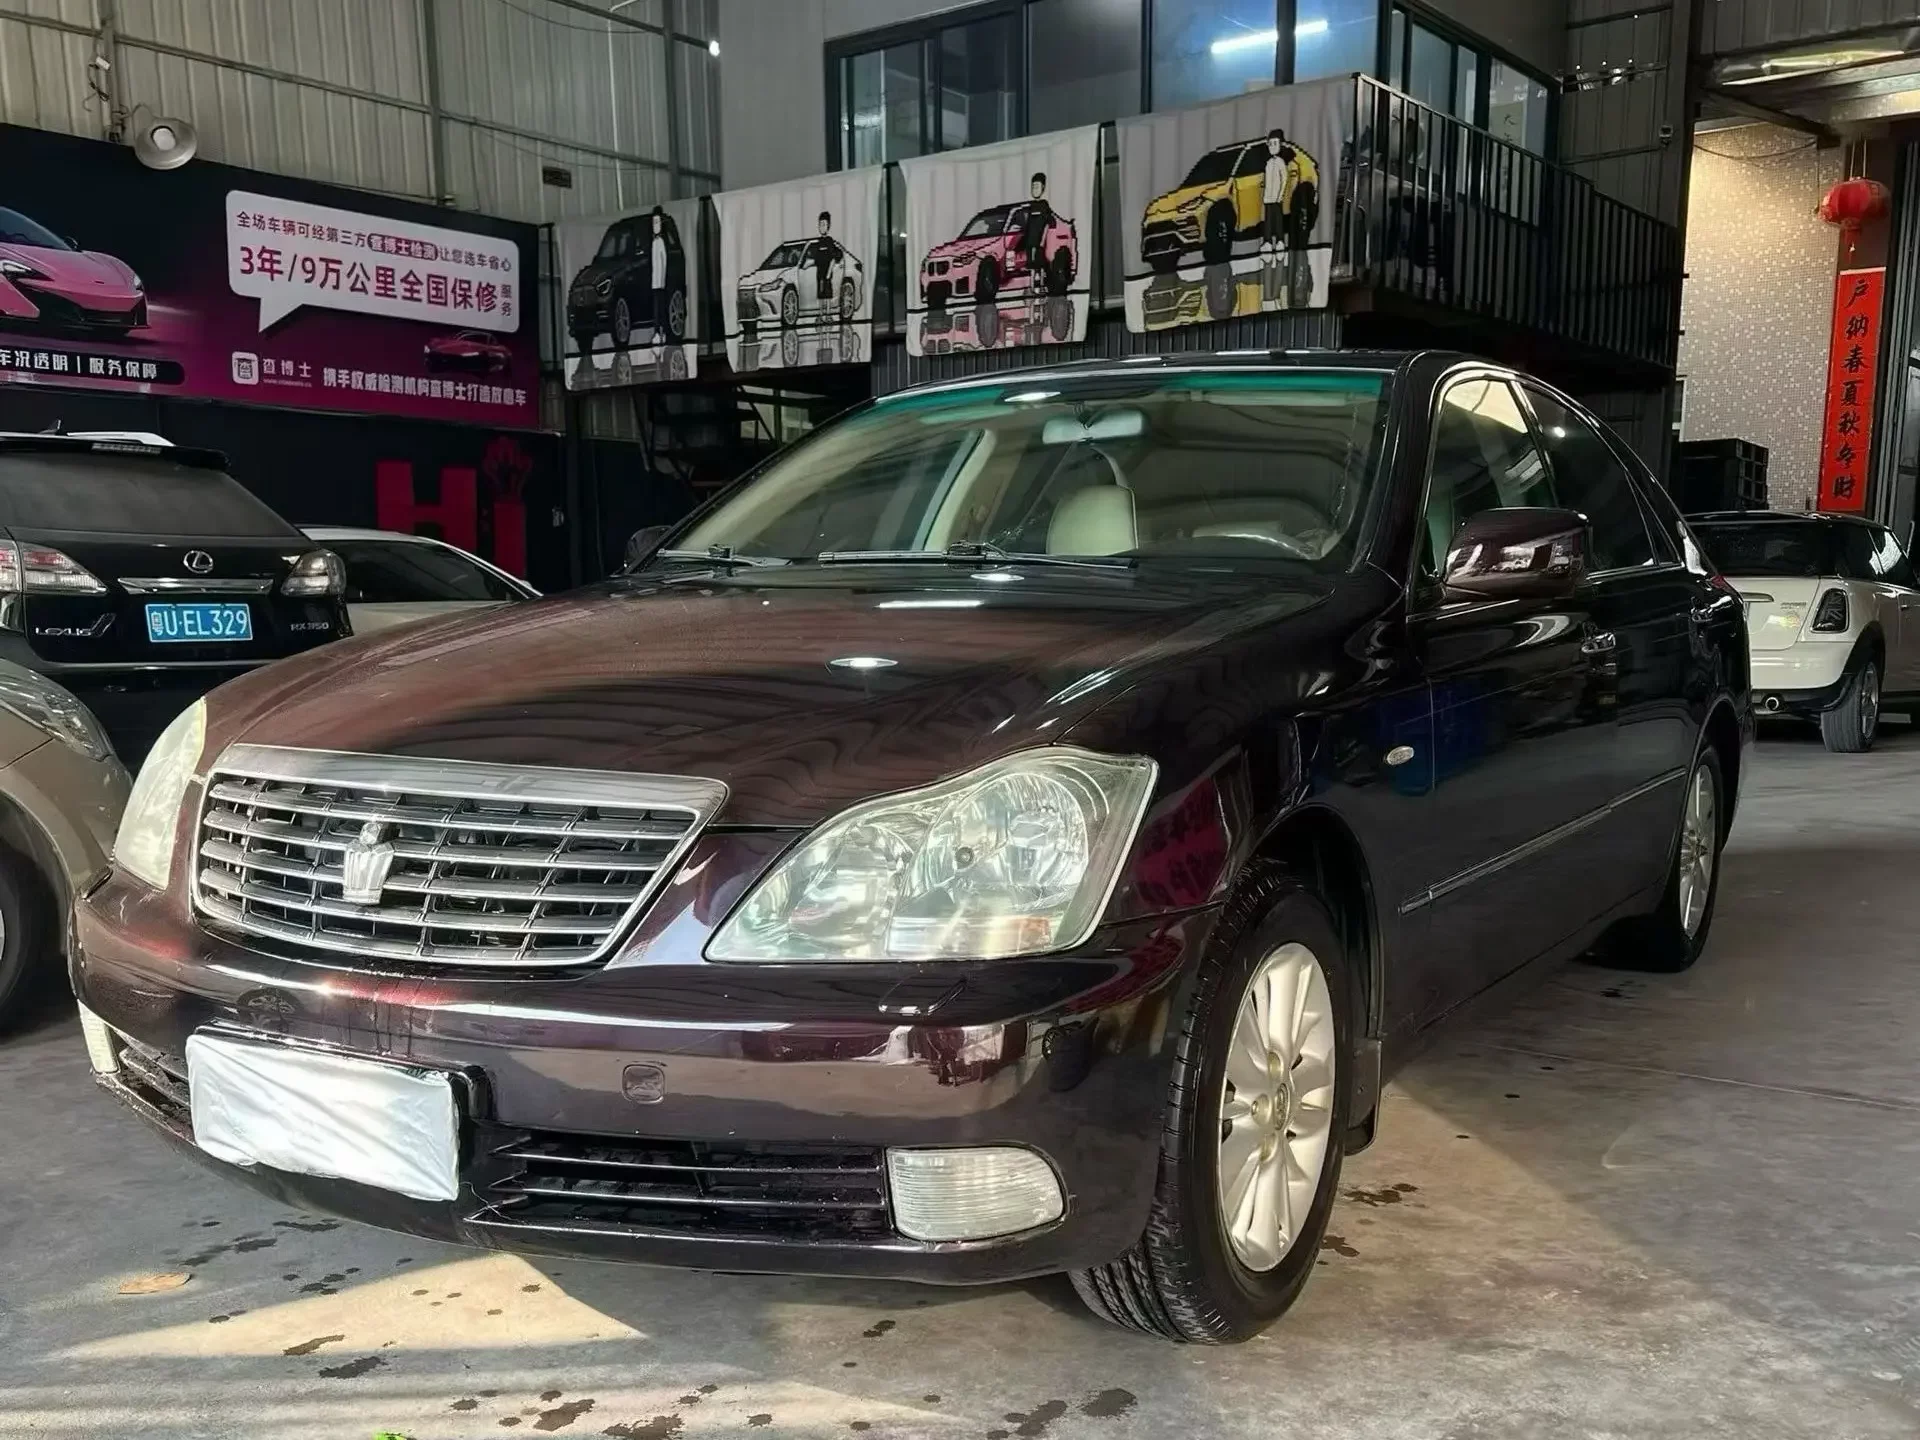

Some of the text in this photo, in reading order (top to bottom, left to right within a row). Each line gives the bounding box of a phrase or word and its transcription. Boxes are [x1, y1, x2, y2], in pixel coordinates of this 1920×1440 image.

[239, 246, 498, 313] 3年/9万公里全国保修
[89, 357, 157, 379] 服务保障
[262, 357, 312, 378] 查博士
